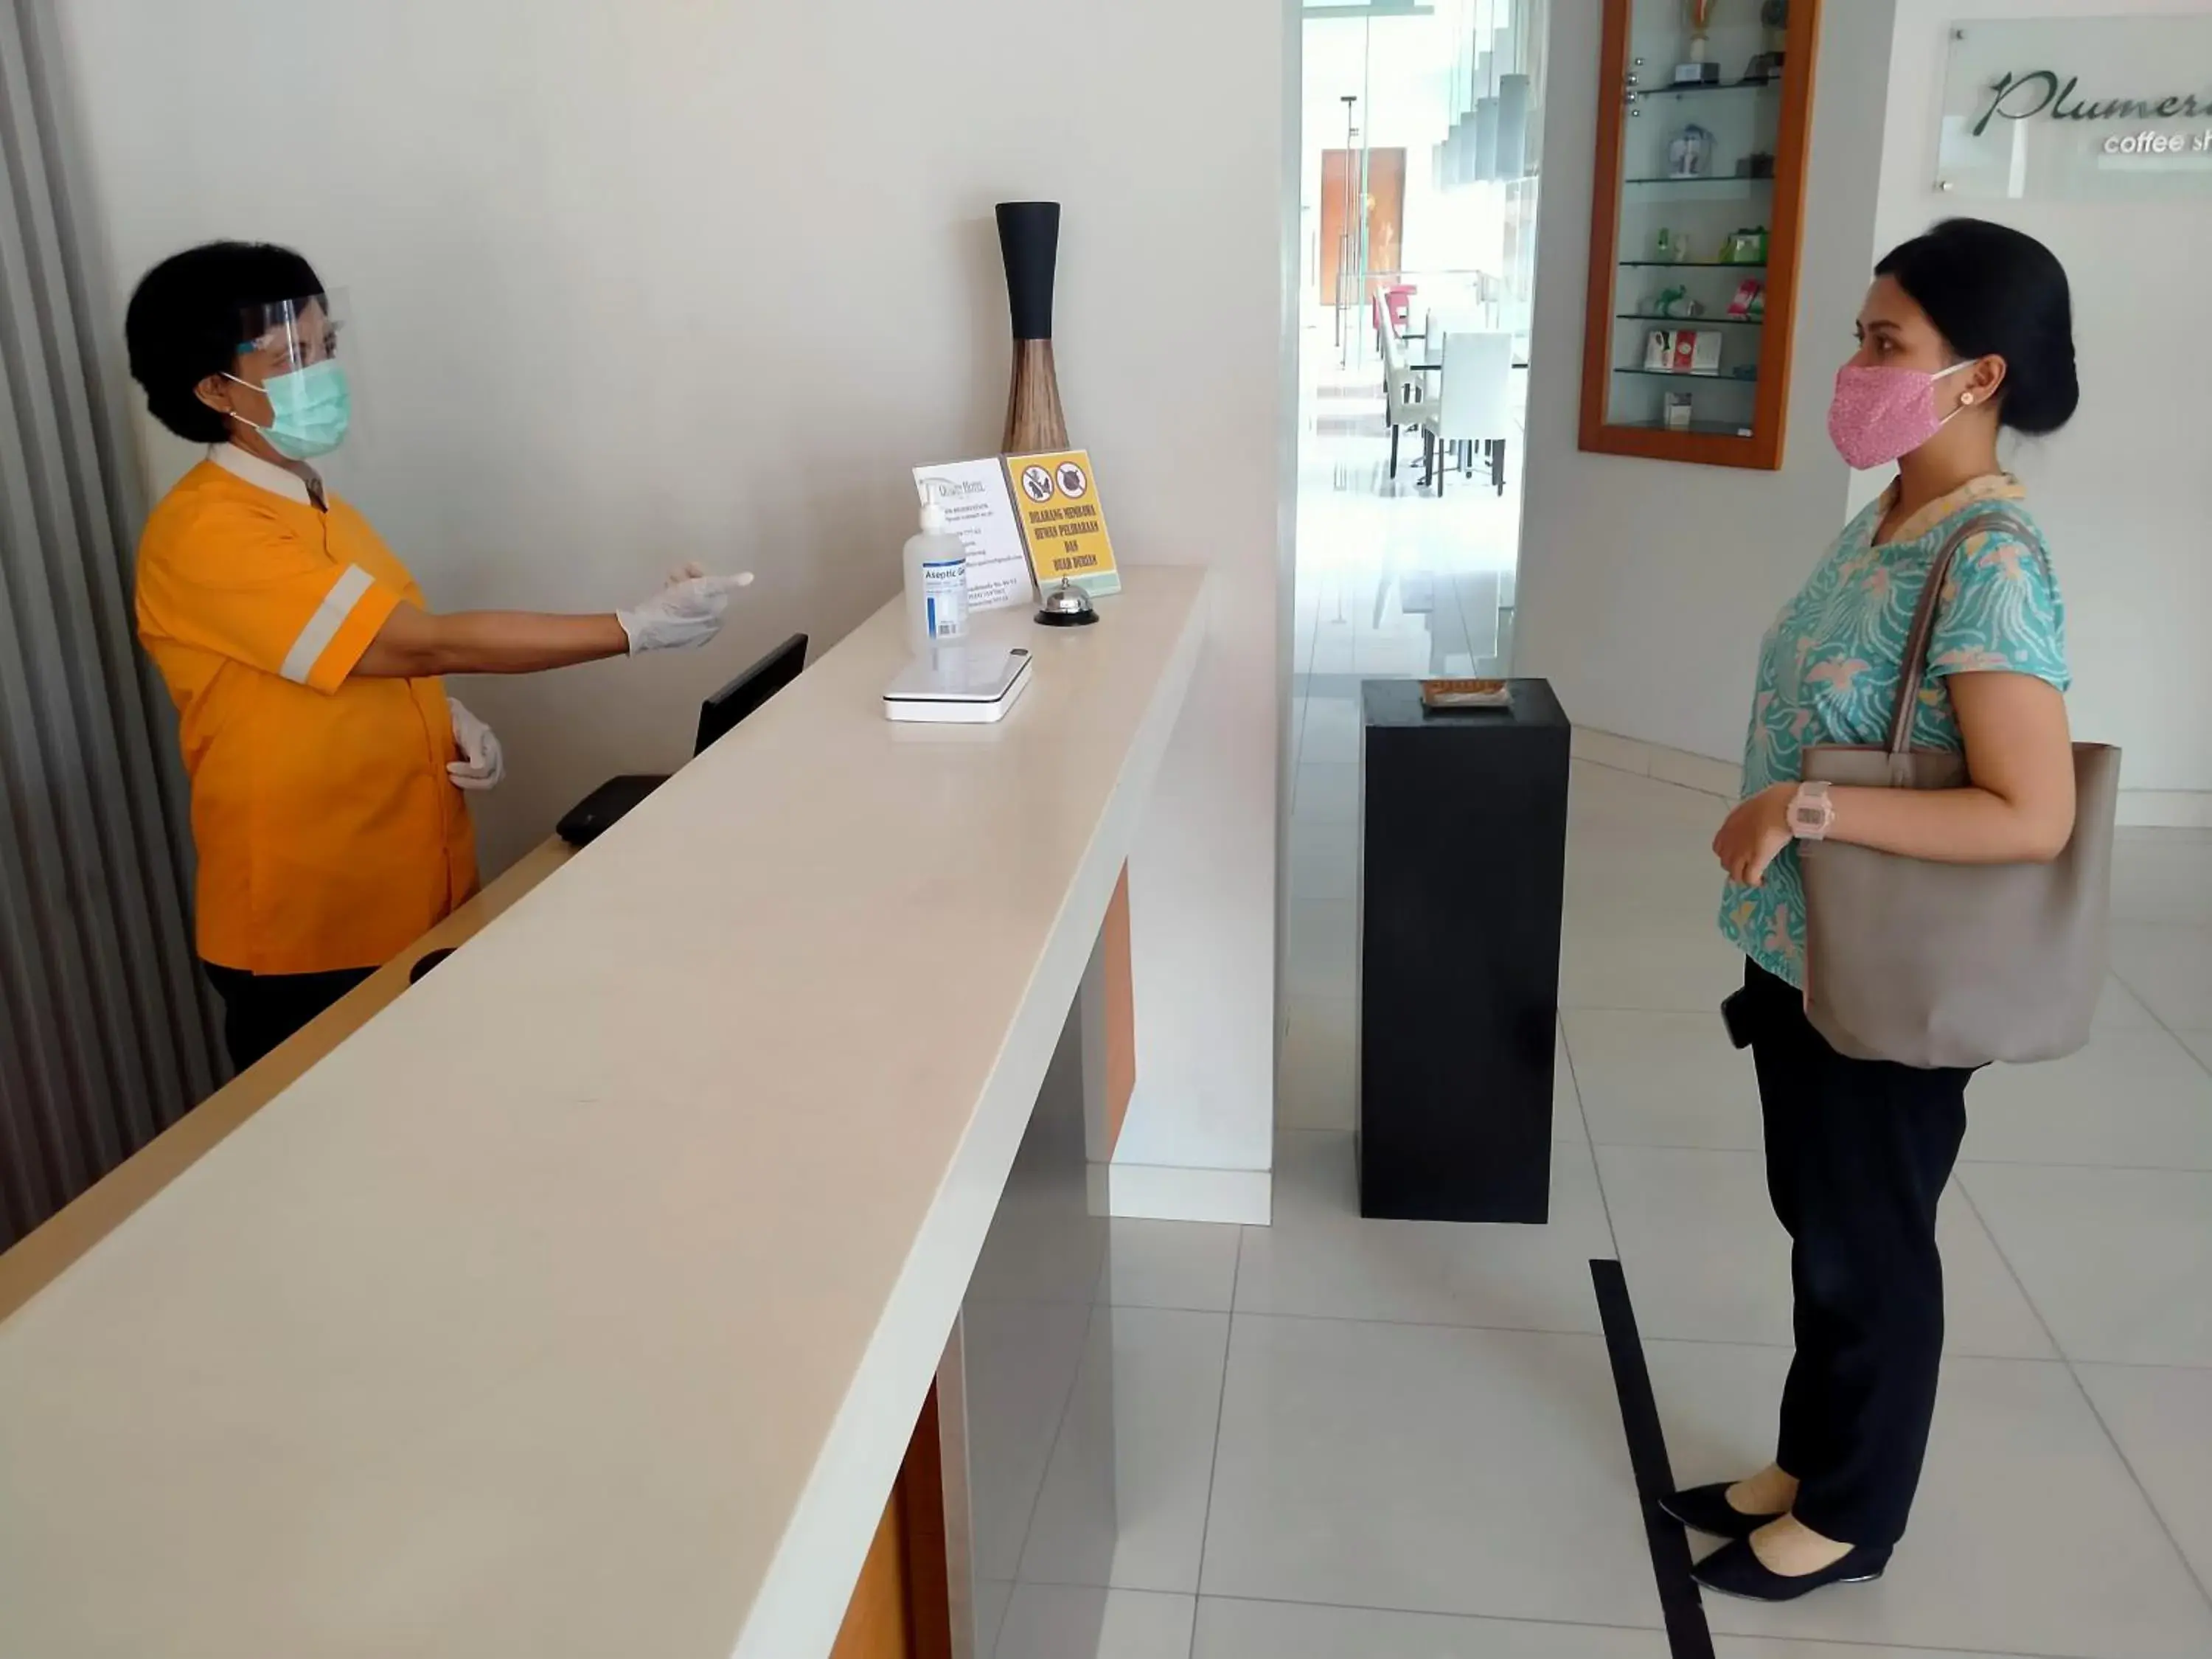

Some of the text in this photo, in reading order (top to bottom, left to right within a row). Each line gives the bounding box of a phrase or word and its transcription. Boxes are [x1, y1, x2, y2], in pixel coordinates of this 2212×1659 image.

[2104, 131, 2185, 153] coffee
[1064, 540, 1078, 553] DAN
[925, 570, 956, 580] Aseptic
